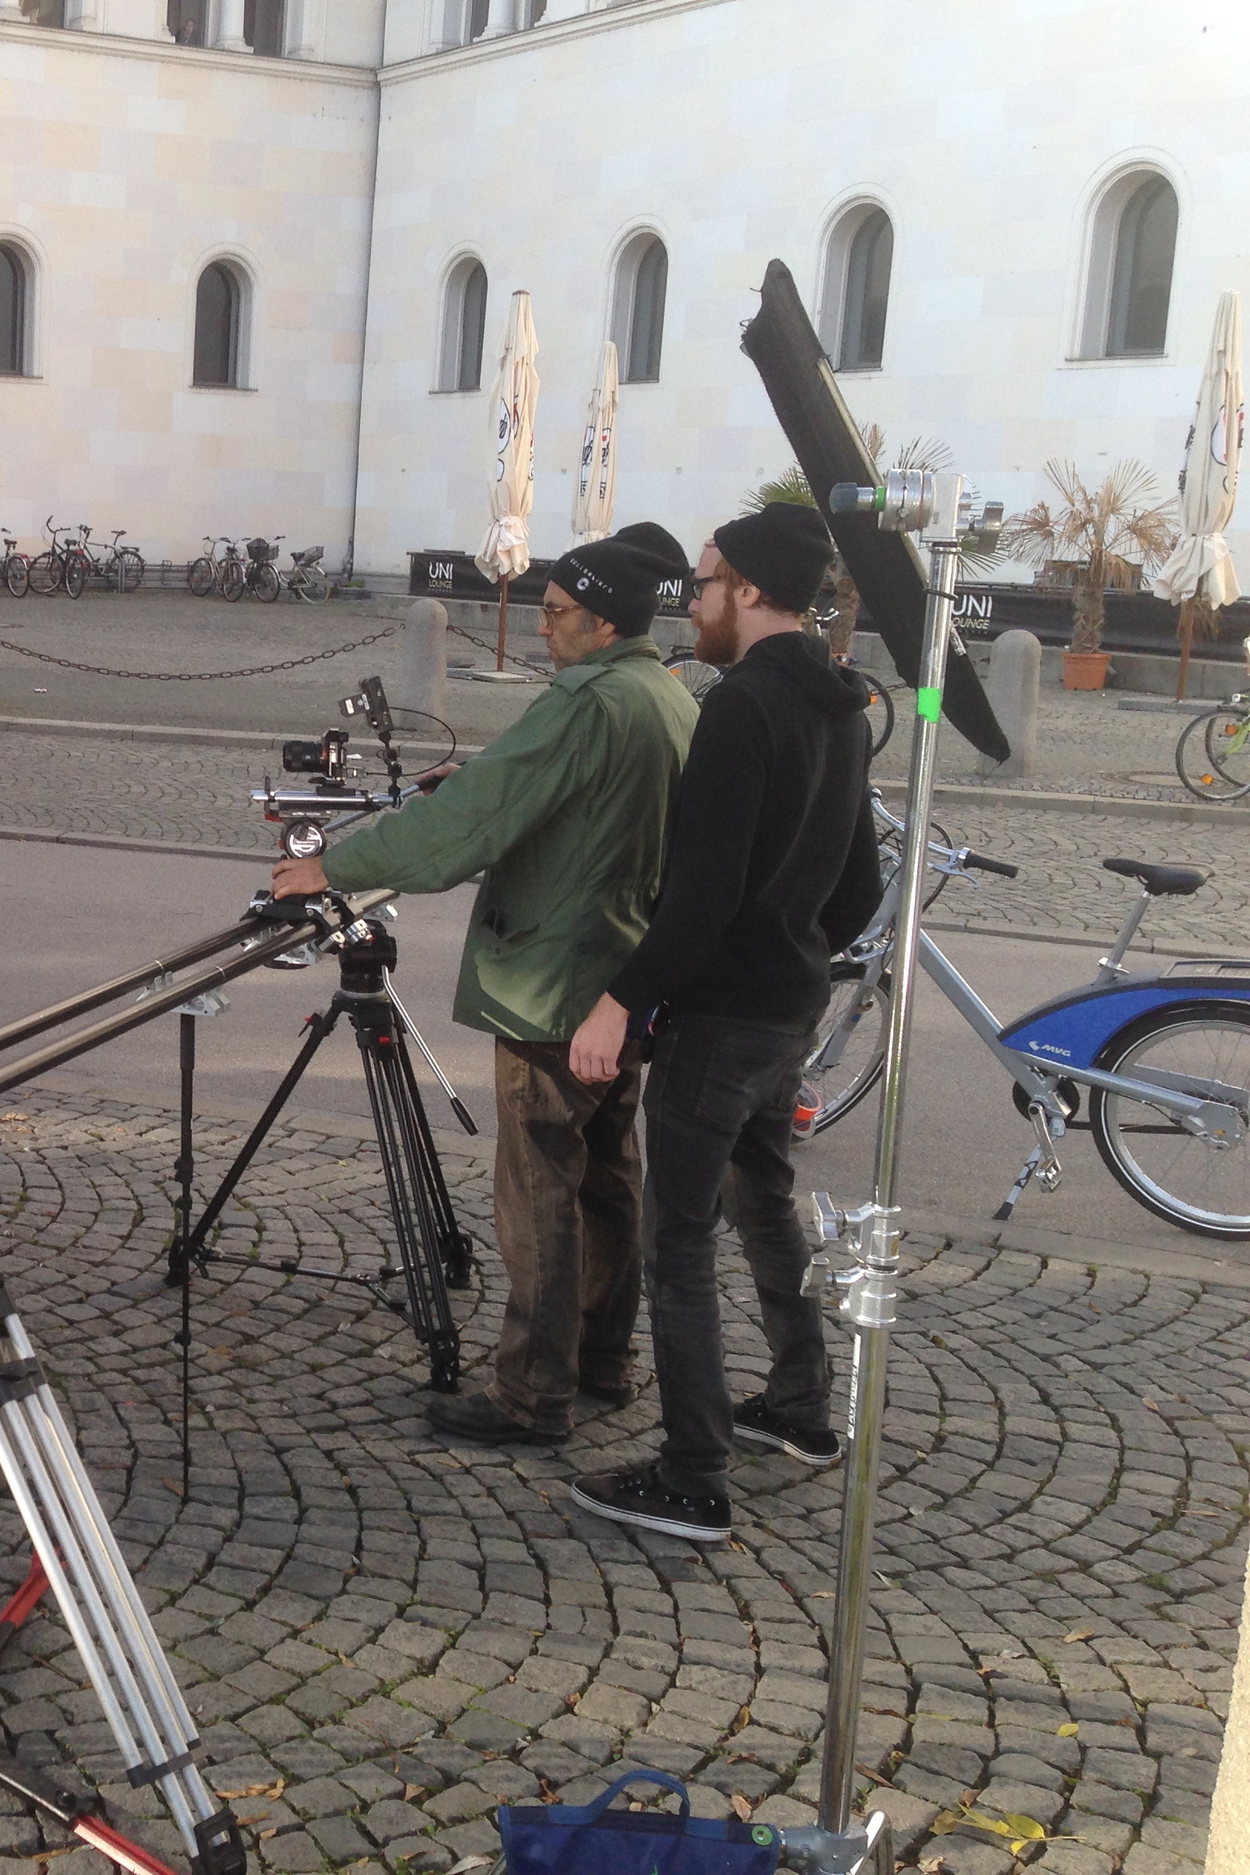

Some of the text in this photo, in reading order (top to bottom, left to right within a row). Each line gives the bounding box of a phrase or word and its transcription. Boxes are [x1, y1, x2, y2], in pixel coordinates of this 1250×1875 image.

[428, 561, 453, 580] UNI
[950, 594, 992, 617] UNI
[952, 617, 990, 630] OUNGE
